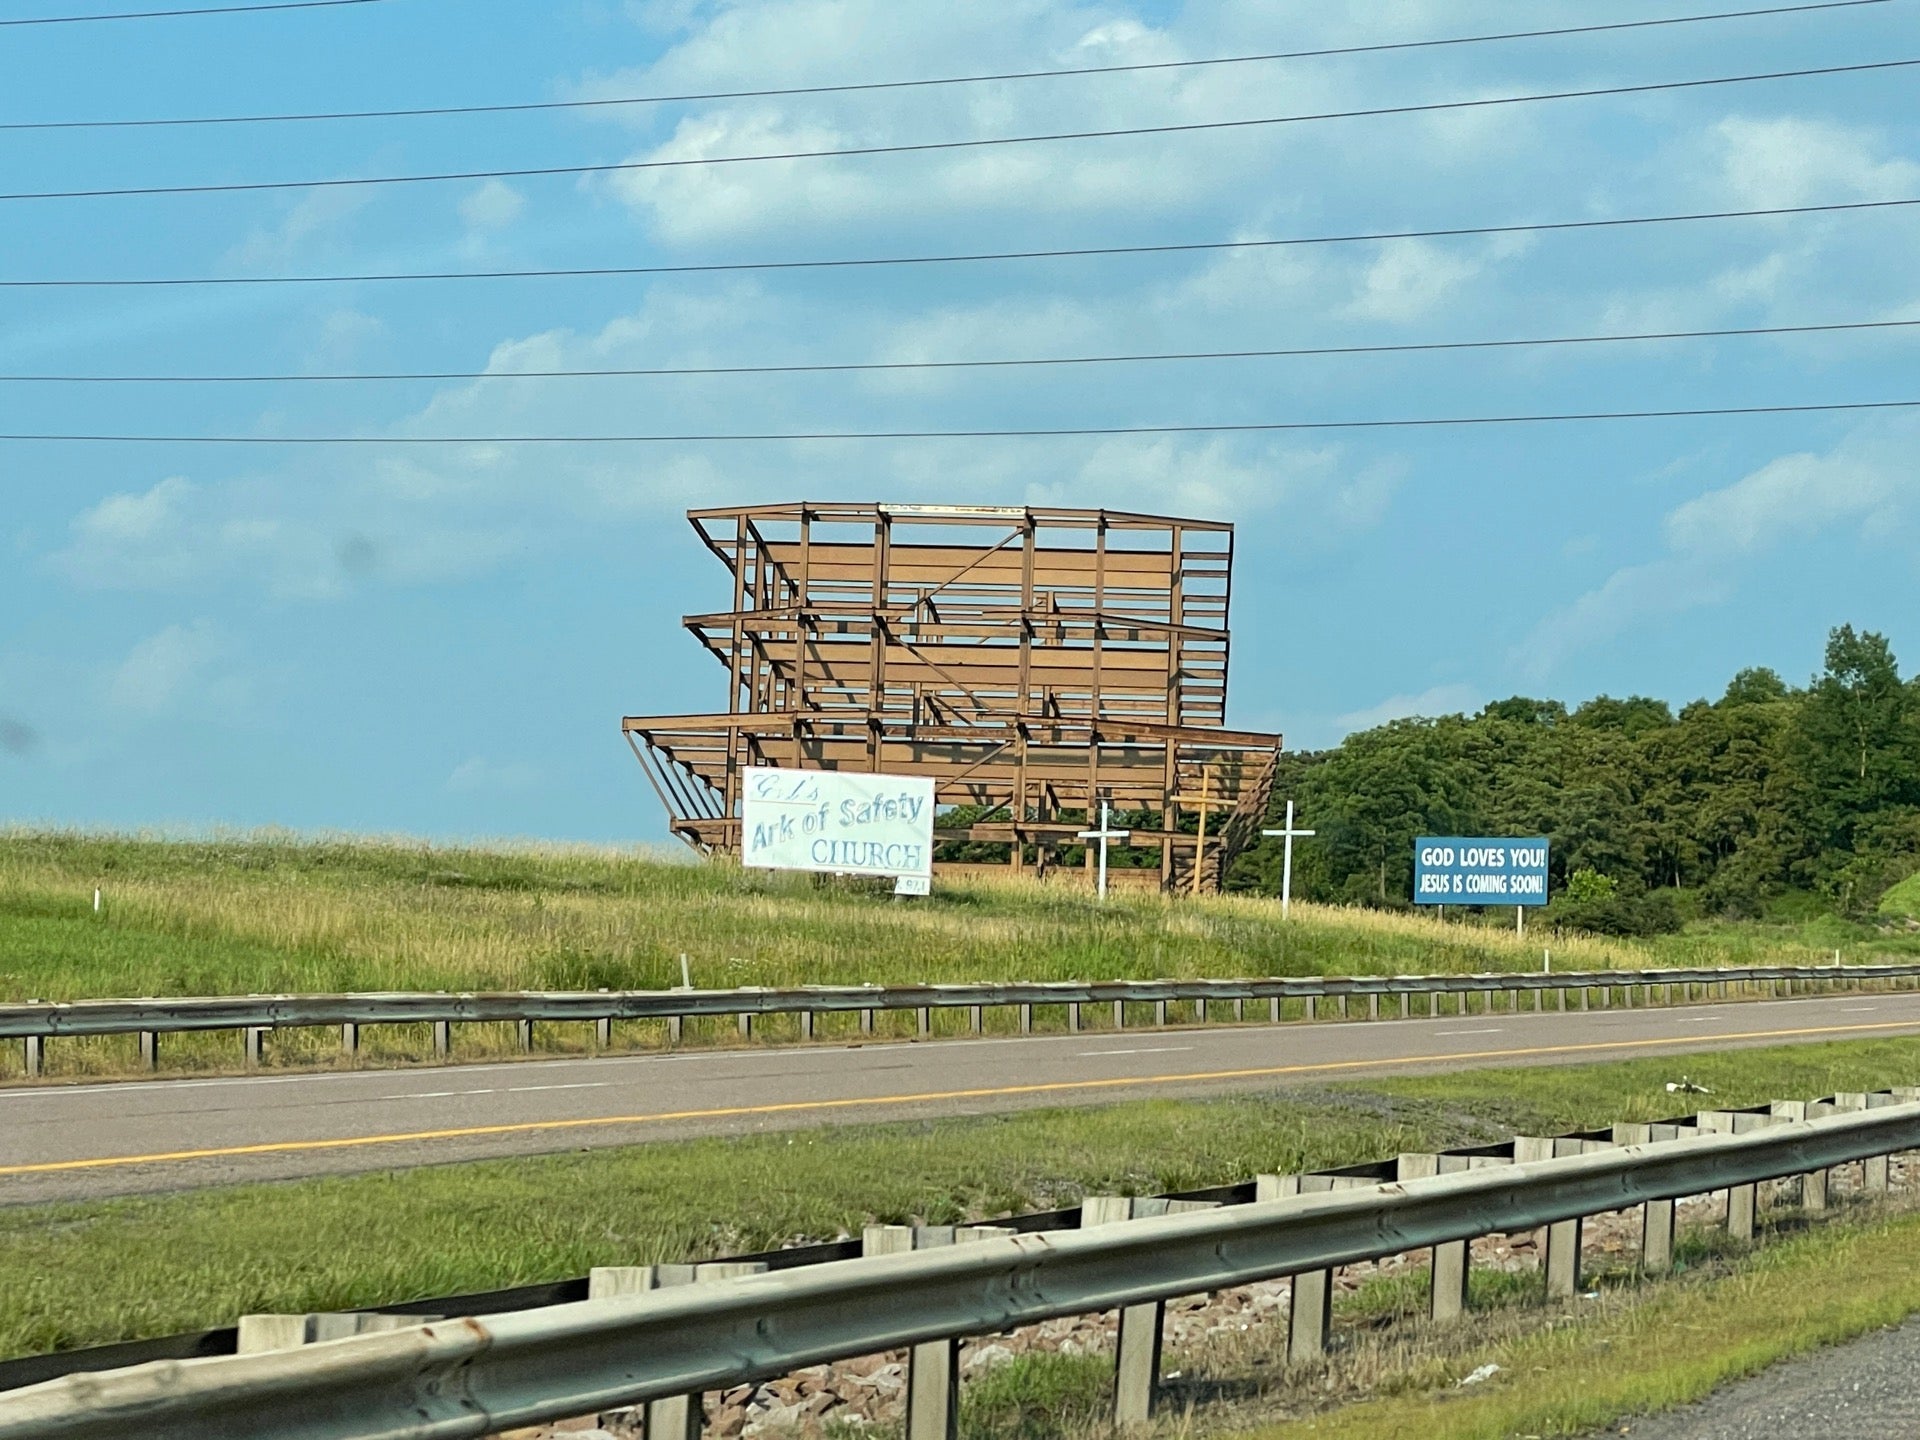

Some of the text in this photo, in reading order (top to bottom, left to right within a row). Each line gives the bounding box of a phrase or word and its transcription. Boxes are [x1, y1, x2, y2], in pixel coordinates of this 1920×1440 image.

[752, 792, 924, 853] Ark of Safety
[811, 838, 922, 868] CHURCH
[1421, 847, 1545, 868] GOD LOVES YOU!
[1420, 873, 1543, 894] JESUS IS COMING SOON!
